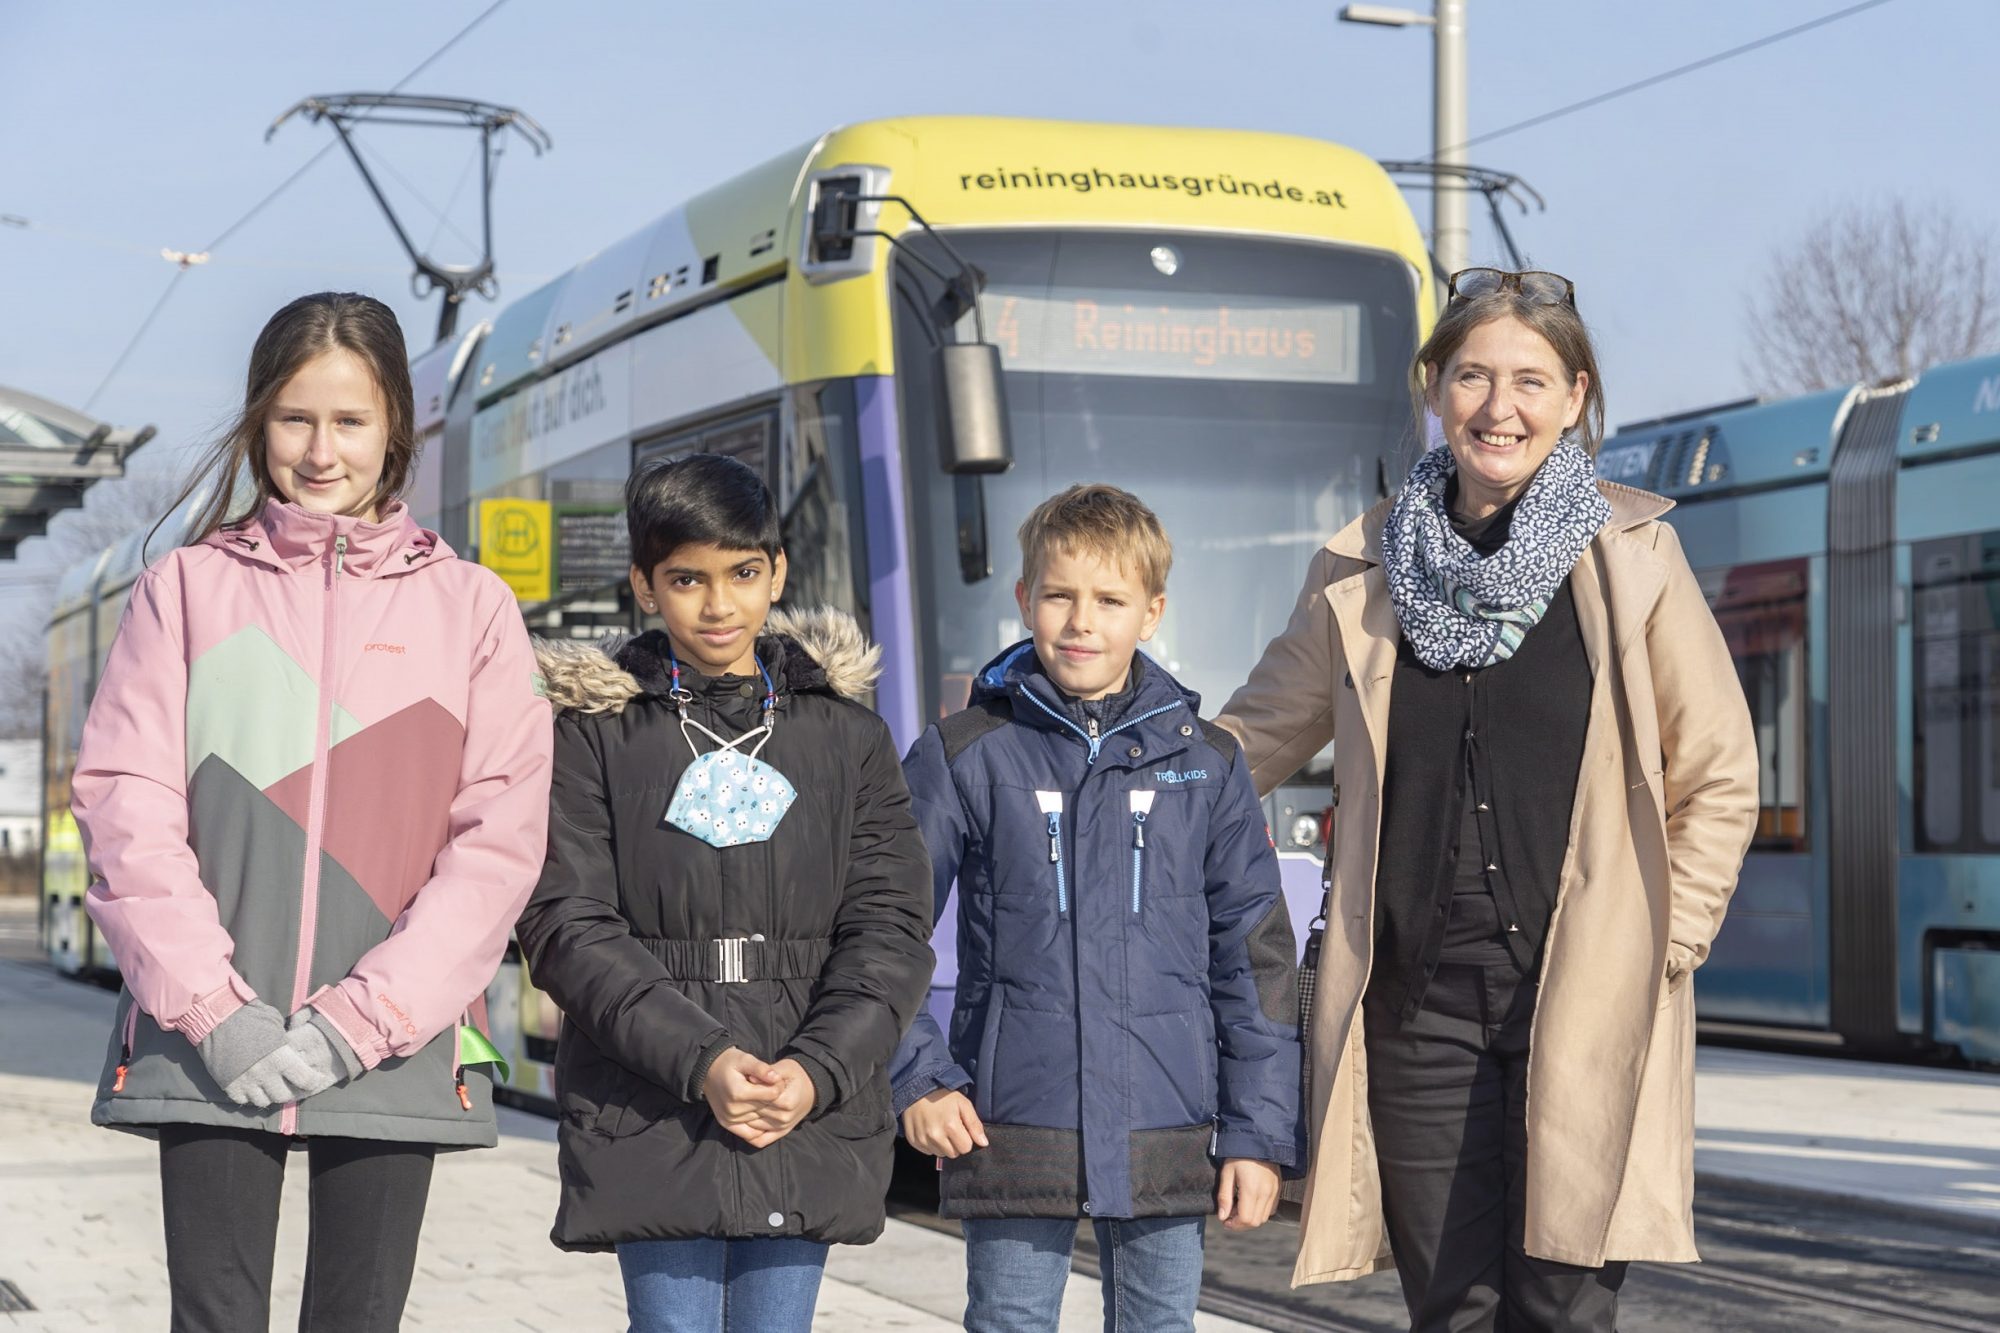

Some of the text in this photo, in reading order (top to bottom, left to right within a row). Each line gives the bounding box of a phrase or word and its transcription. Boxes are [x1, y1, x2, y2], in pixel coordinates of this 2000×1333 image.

[960, 167, 1347, 208] reininghausgründe.at
[997, 298, 1315, 367] 4 Reininghaus
[364, 643, 407, 655] protest
